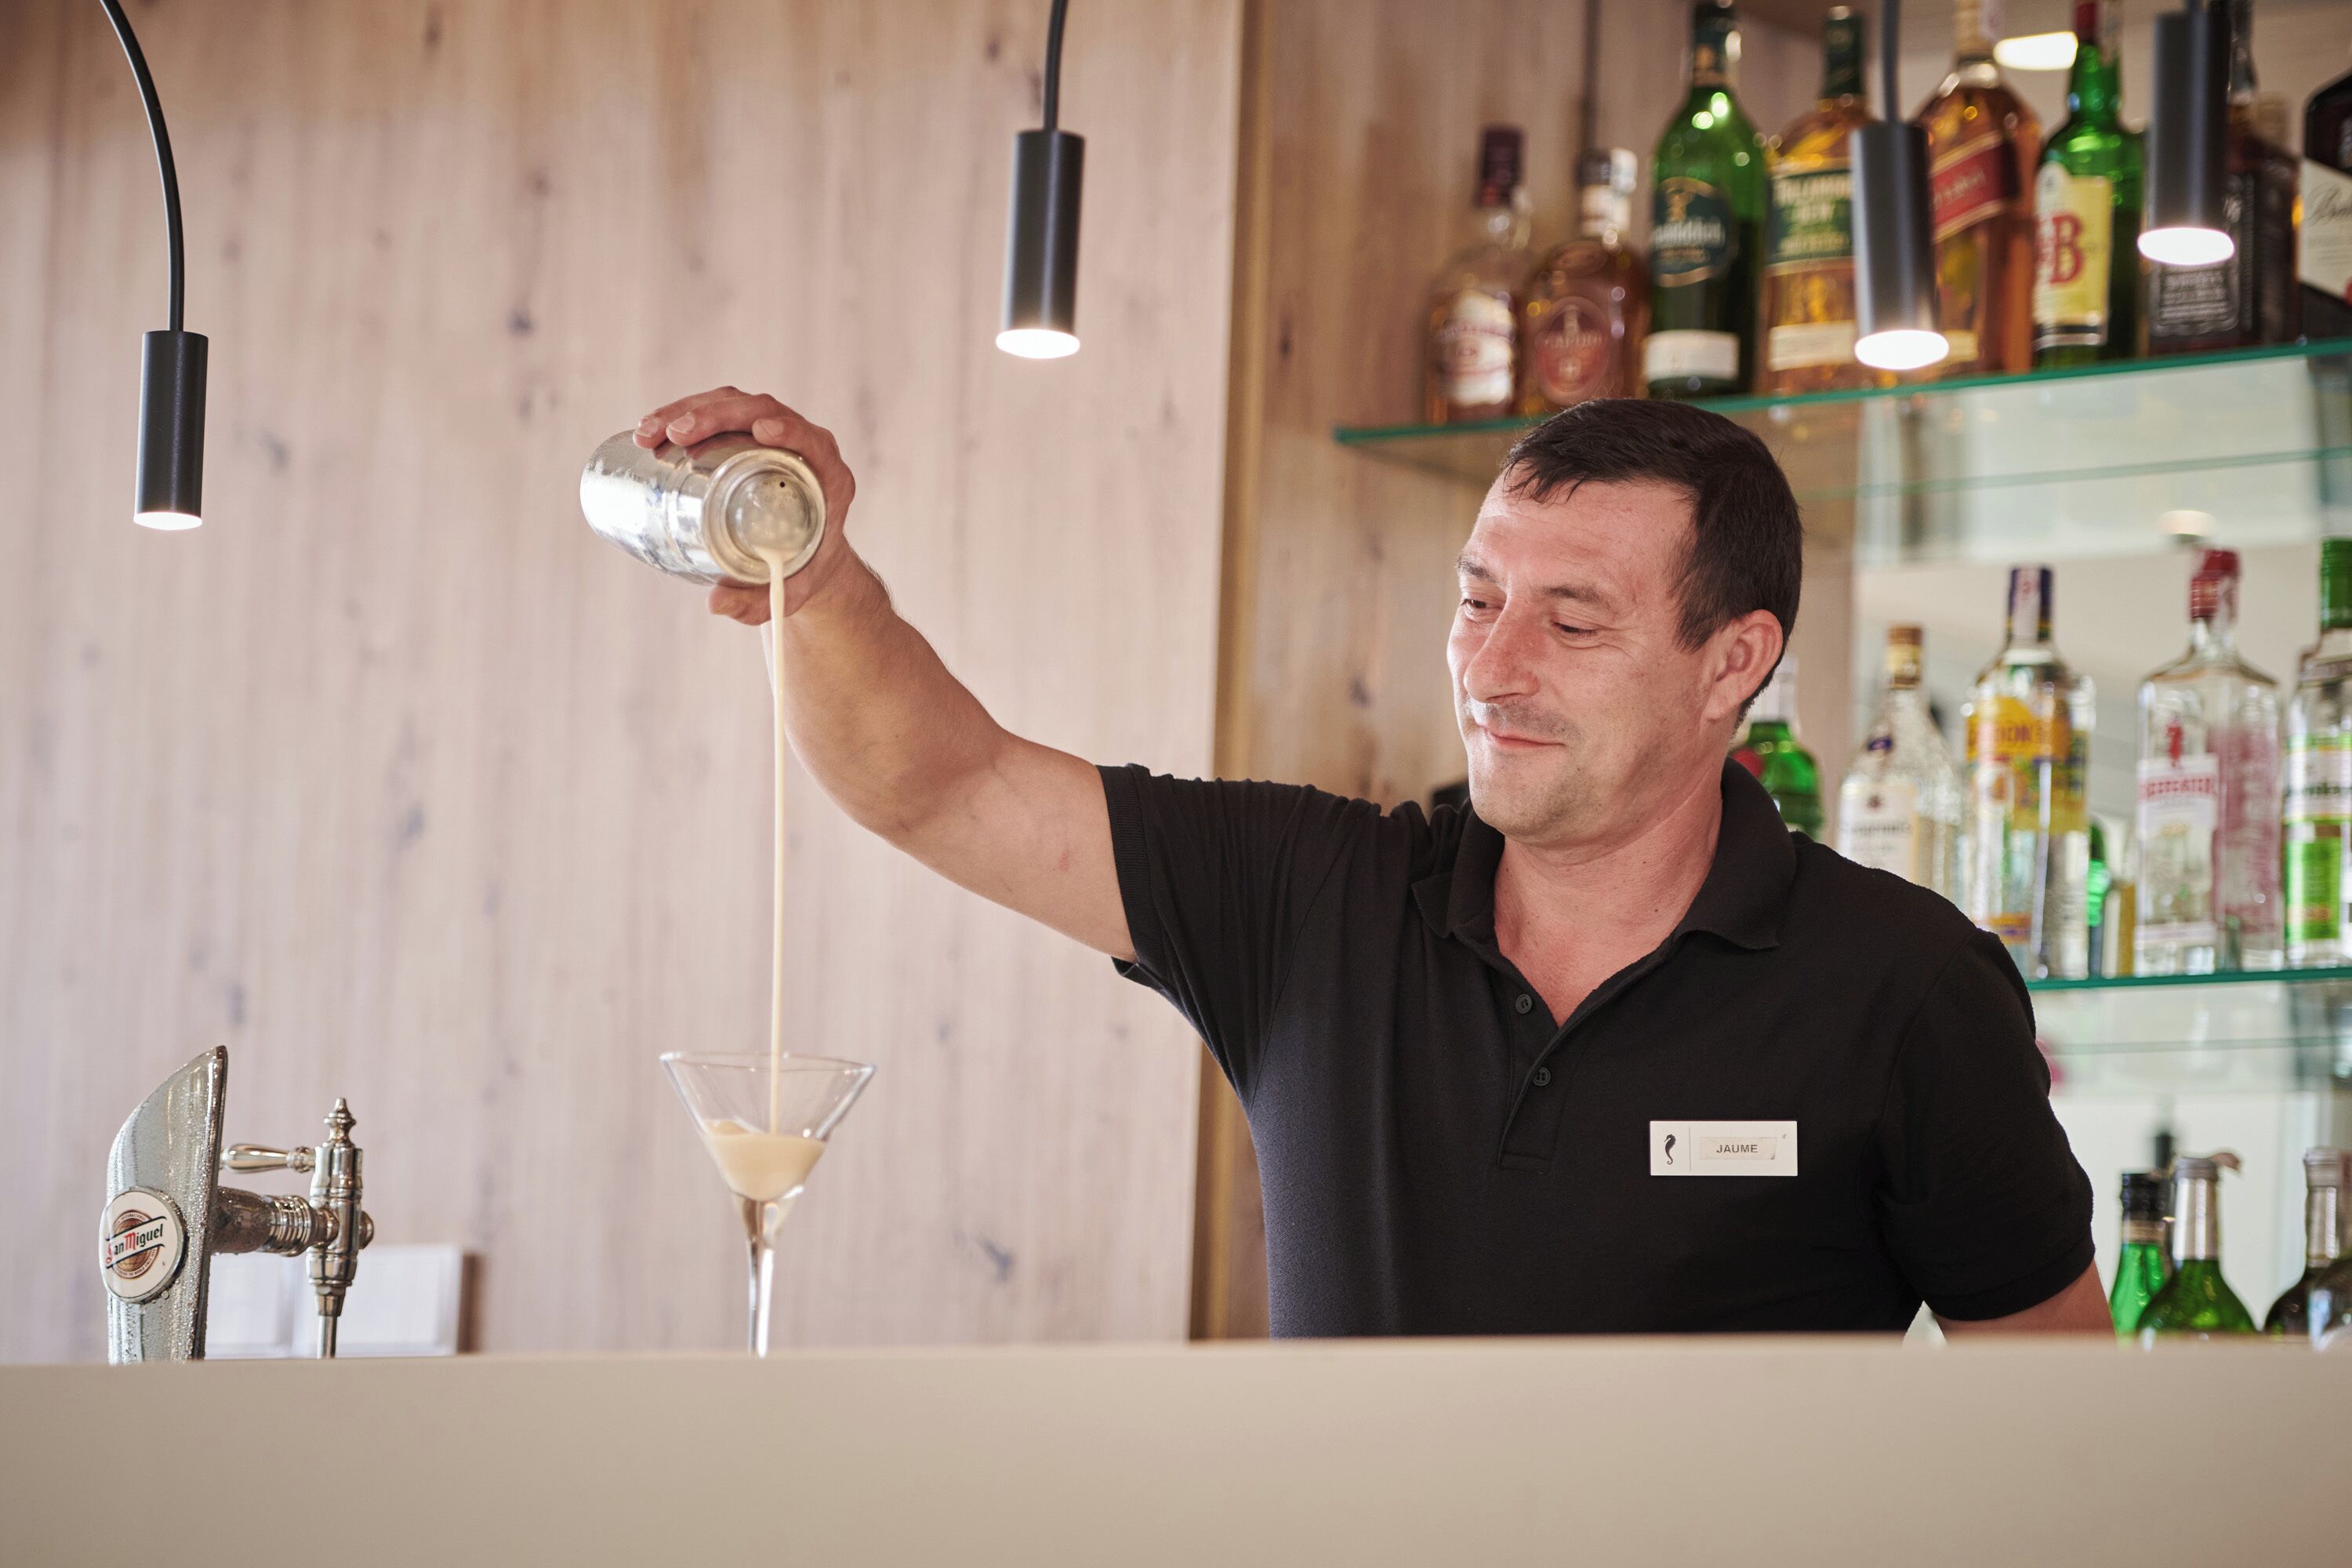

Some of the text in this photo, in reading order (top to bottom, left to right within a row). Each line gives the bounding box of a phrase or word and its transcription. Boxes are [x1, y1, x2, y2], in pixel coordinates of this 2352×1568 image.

[1716, 1144, 1758, 1153] JAUME
[105, 1223, 163, 1264] San Miguel
